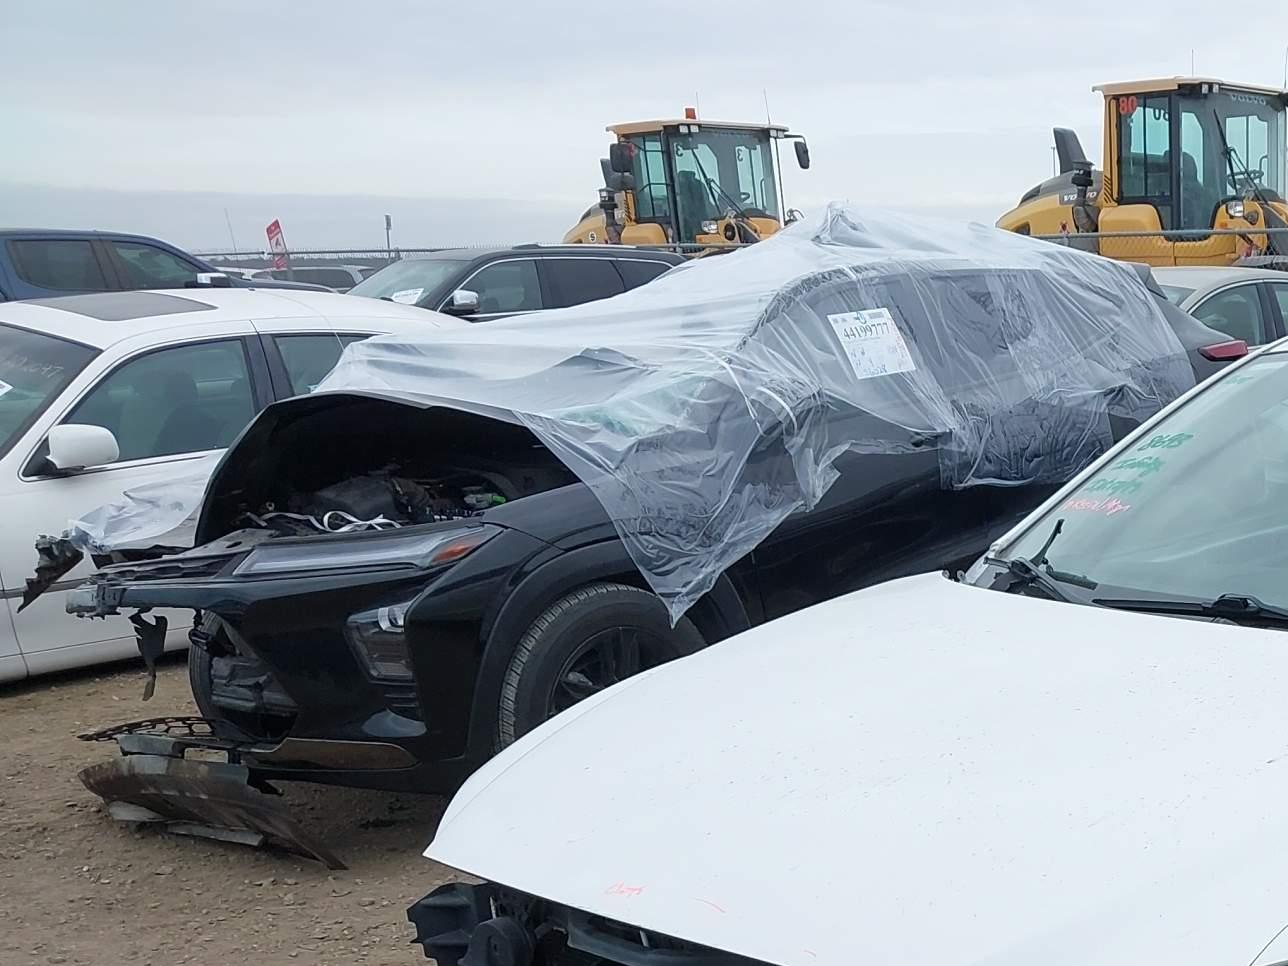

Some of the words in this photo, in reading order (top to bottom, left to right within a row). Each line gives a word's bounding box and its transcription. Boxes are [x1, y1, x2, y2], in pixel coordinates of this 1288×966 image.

[1119, 96, 1137, 115] 80
[1063, 191, 1097, 201] VOO
[843, 322, 890, 341] 44199777
